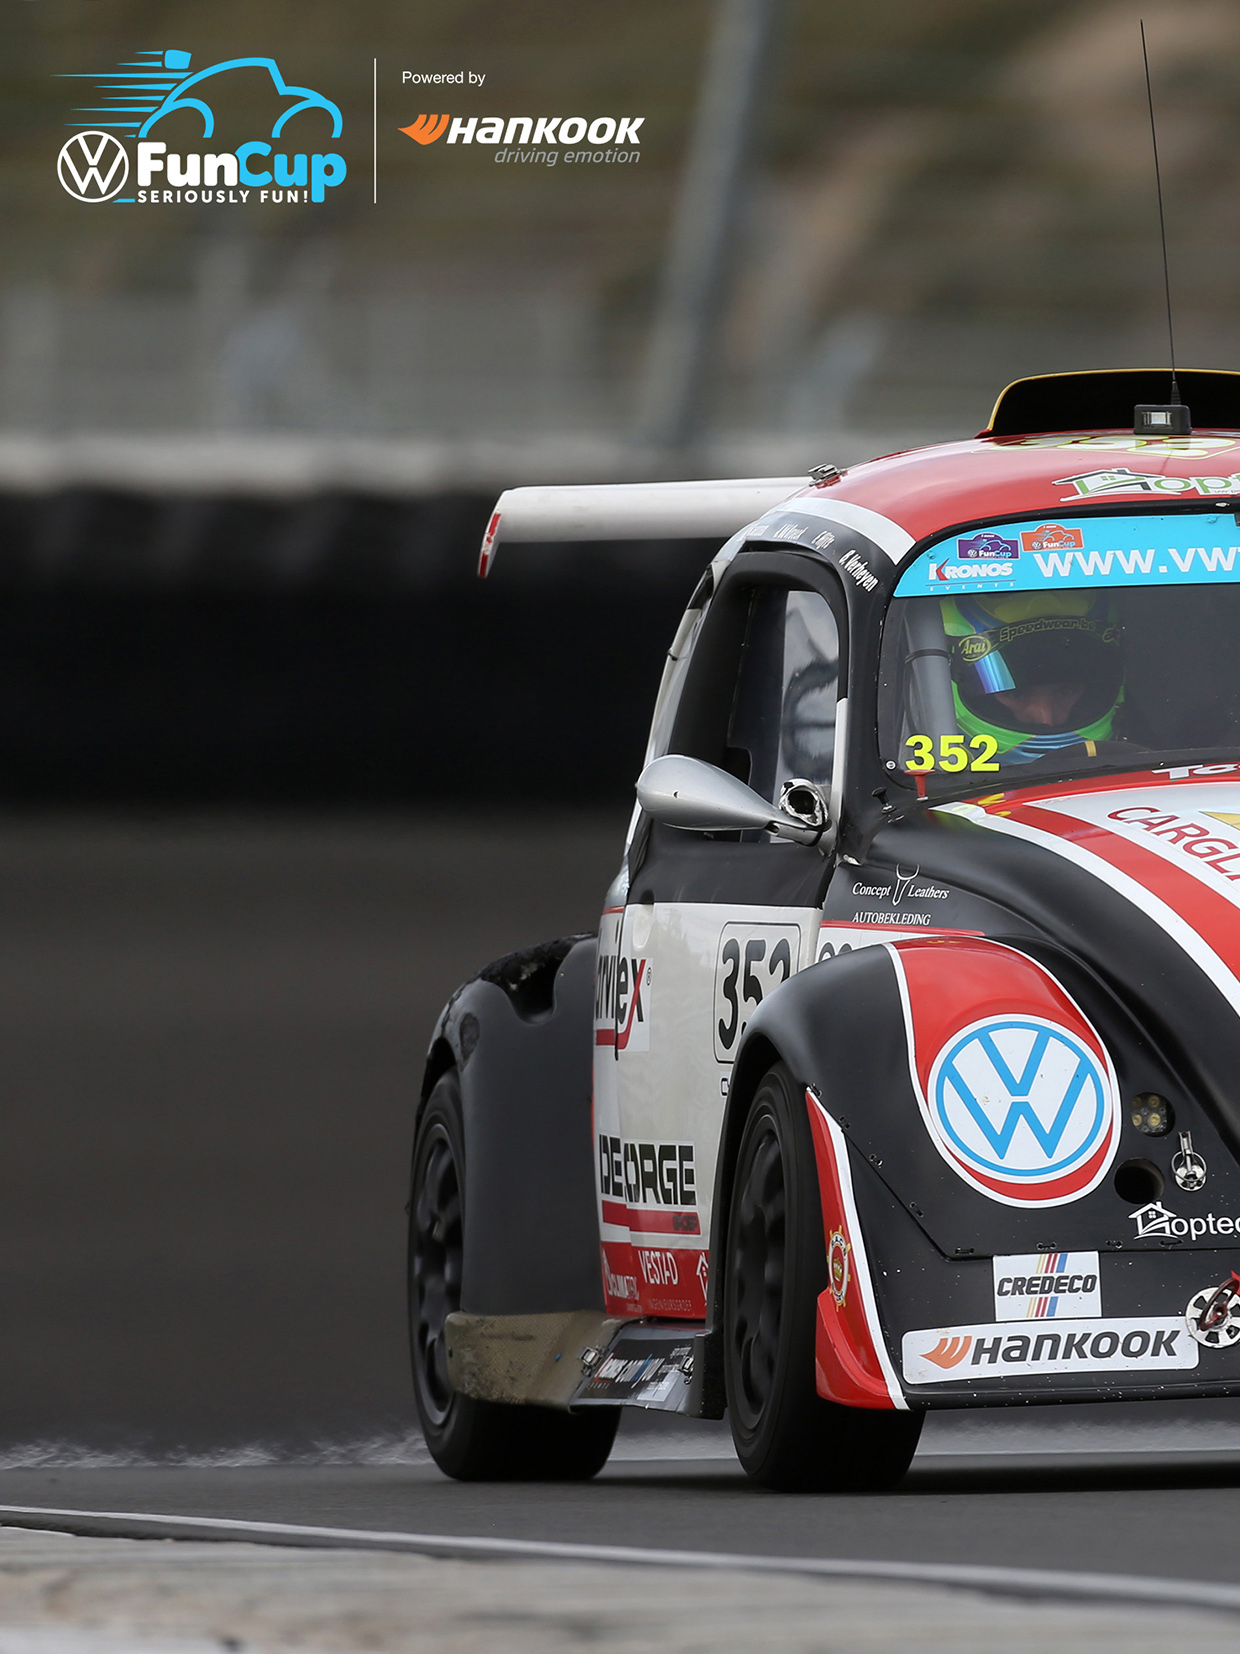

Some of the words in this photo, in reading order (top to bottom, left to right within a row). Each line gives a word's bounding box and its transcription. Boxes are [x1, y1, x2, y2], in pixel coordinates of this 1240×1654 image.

[1043, 540, 1077, 549] FunCup
[979, 550, 1013, 559] FunCup
[928, 558, 1014, 581] KRONOS
[1000, 618, 1096, 642] Speedwear.be
[961, 639, 987, 655] Arai
[905, 735, 1000, 772] 352
[852, 882, 892, 900] Concept
[907, 884, 950, 899] Leathers
[851, 911, 932, 926] AUTOBEKLEDING
[996, 1273, 1099, 1297] CREDECO
